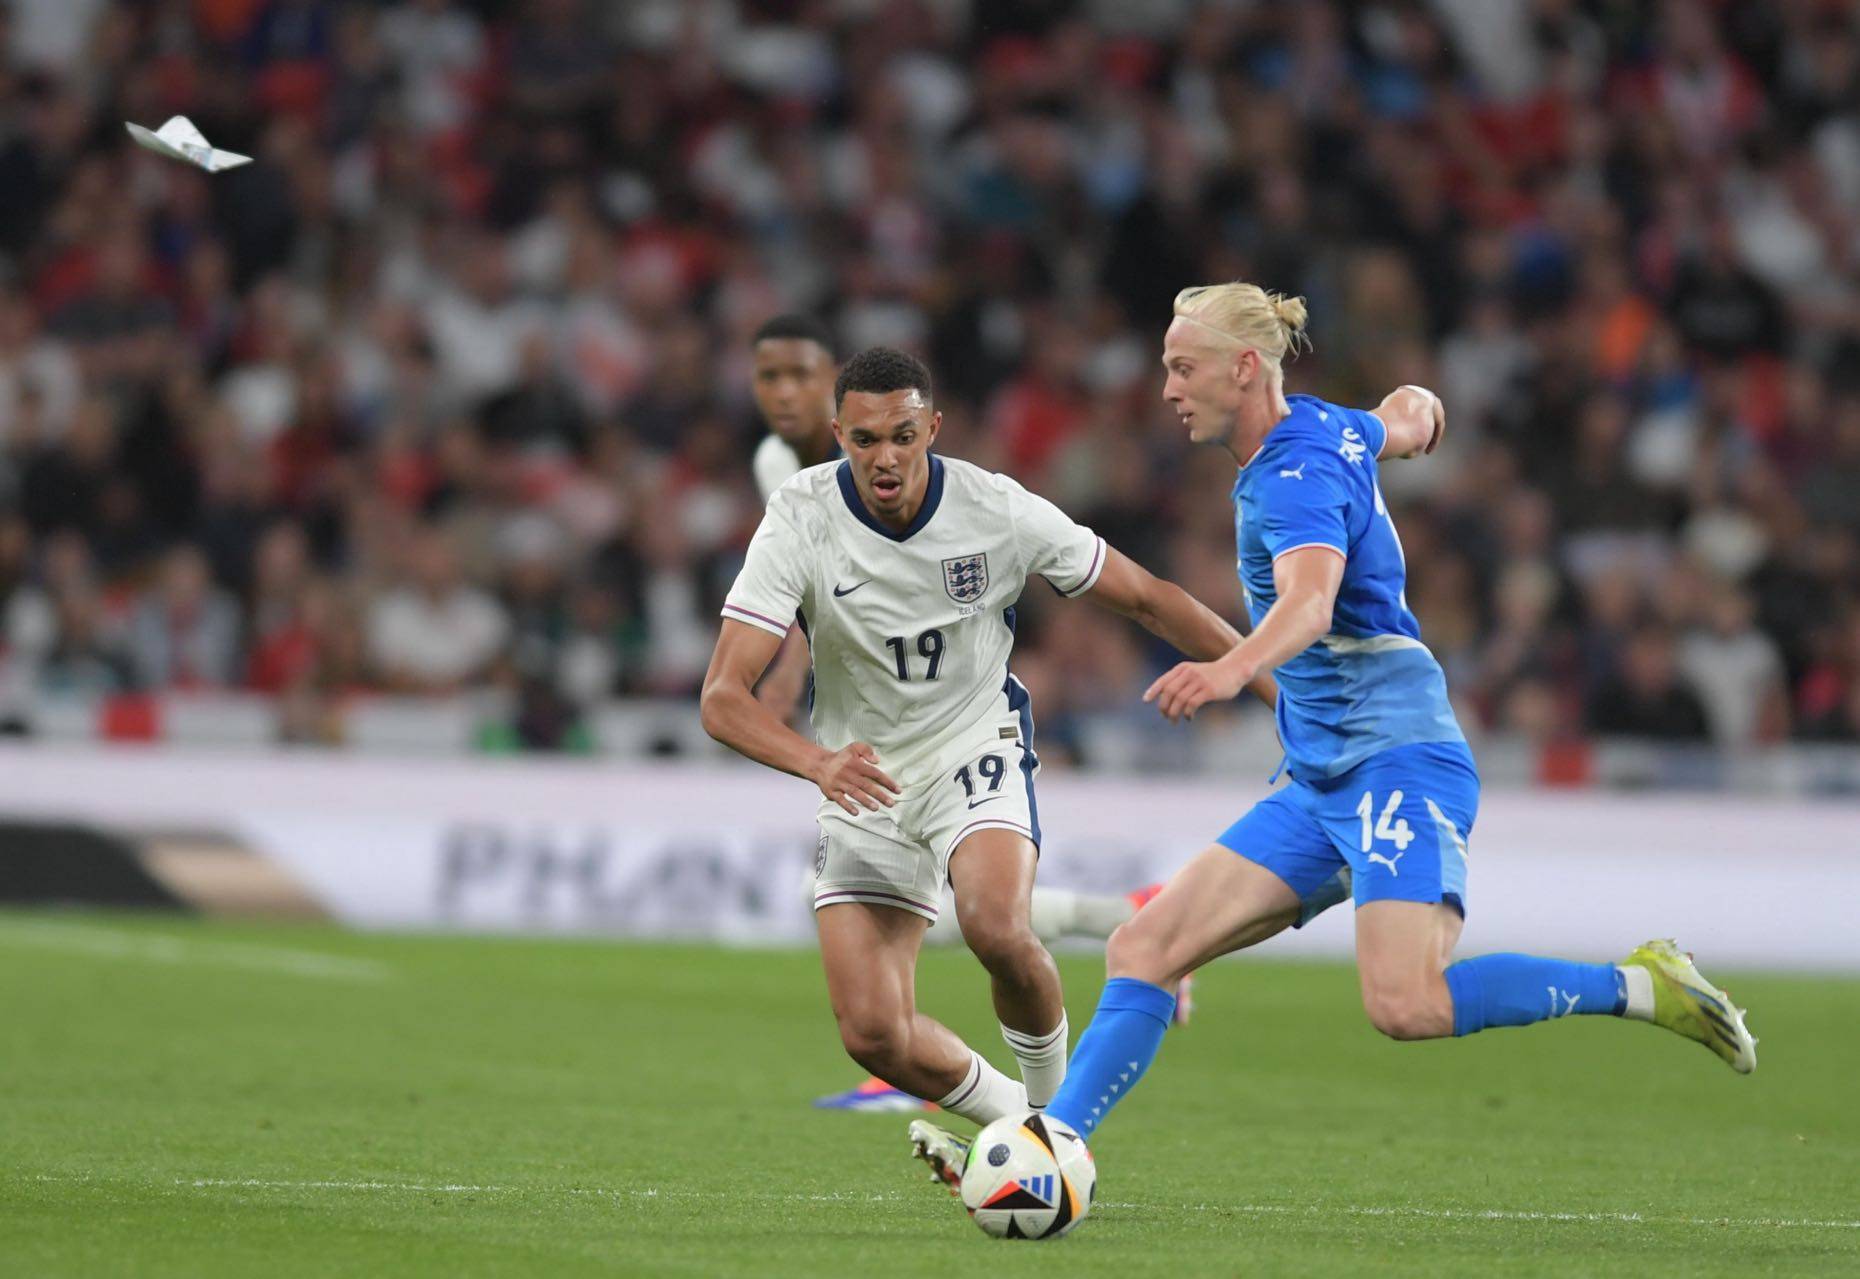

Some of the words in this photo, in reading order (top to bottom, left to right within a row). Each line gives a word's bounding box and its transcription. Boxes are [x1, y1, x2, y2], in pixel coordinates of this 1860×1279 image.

[885, 629, 946, 681] 19
[953, 754, 1007, 797] 19
[1356, 789, 1415, 853] 14
